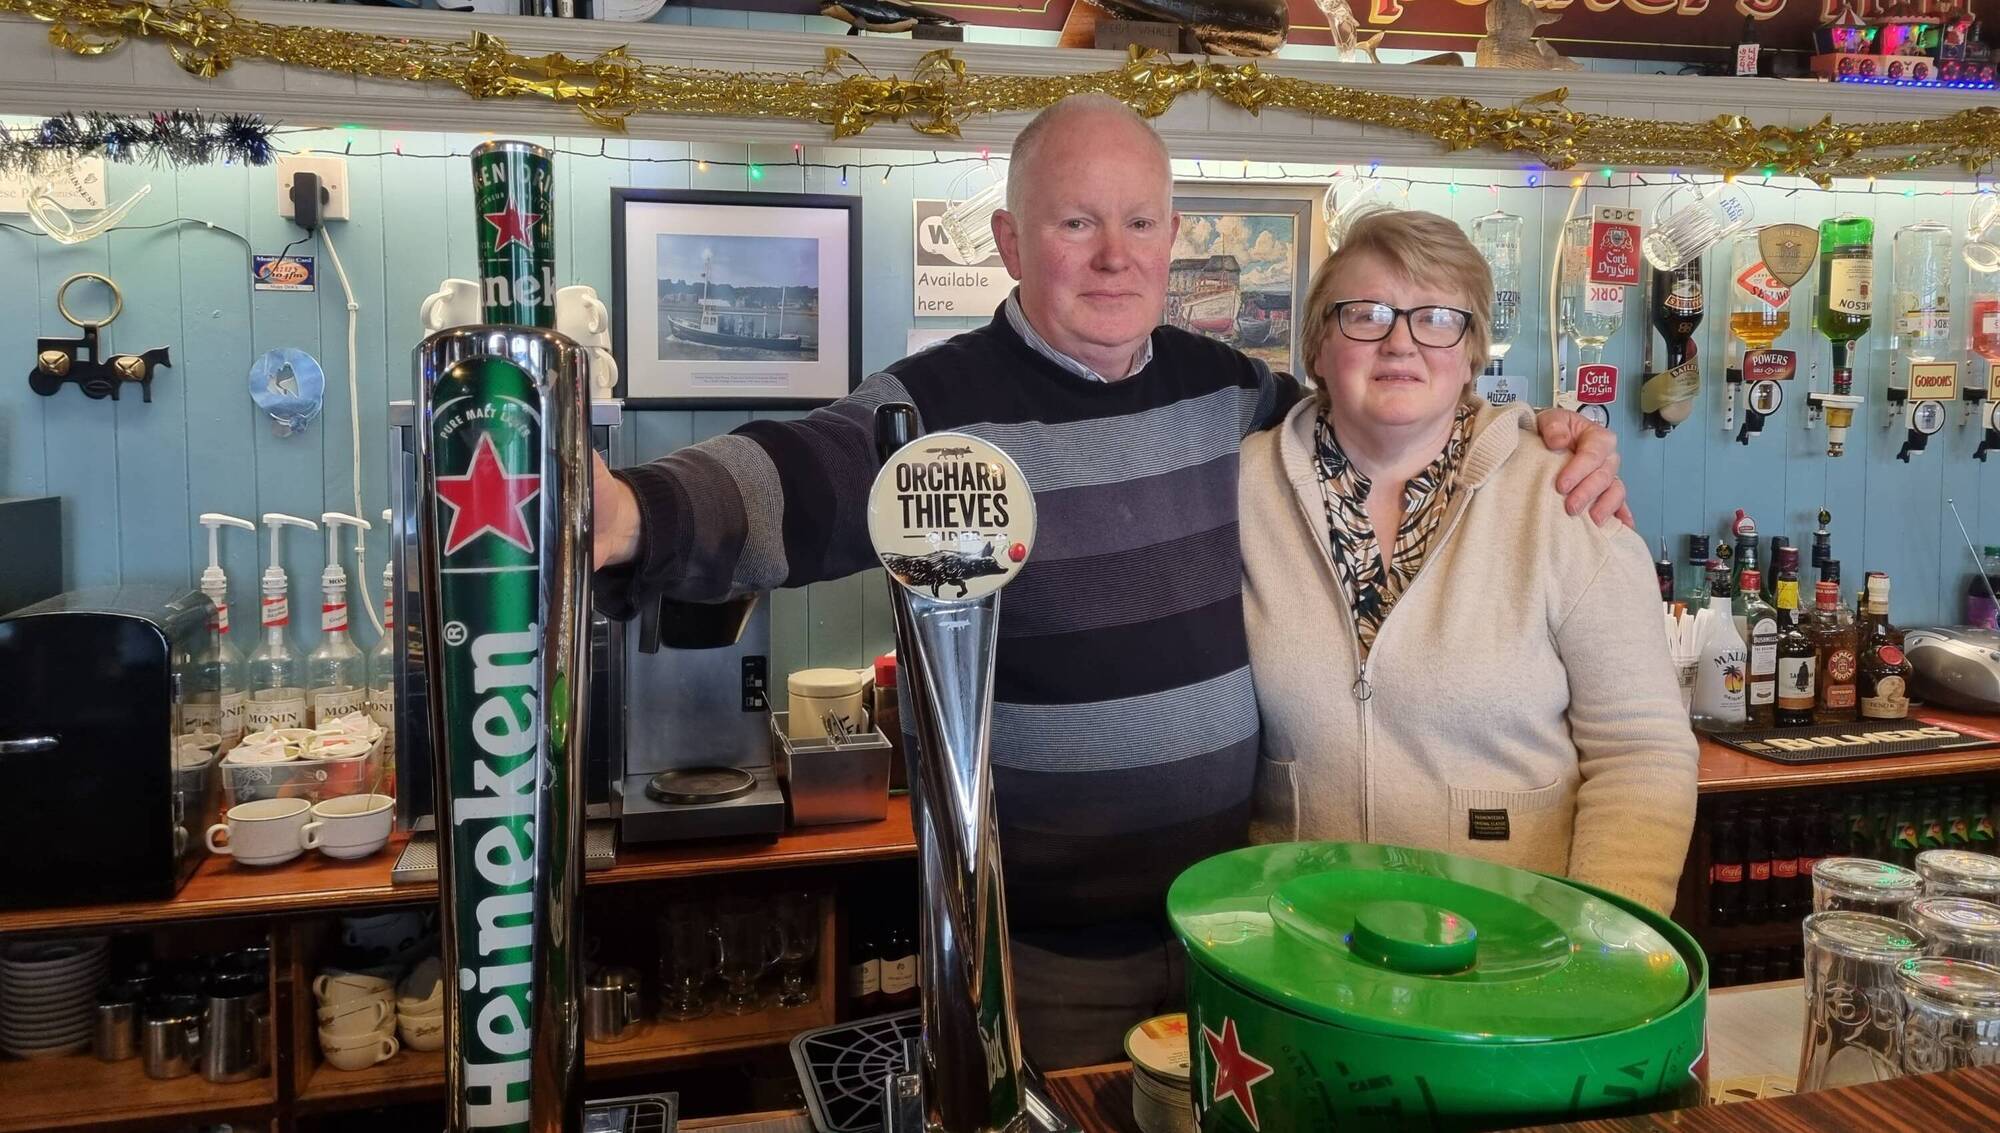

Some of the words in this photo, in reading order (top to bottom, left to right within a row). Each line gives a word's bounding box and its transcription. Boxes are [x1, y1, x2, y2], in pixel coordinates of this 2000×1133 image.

[1606, 252, 1628, 265] Cork
[1597, 260, 1617, 276] Dry
[1617, 264, 1635, 278] Gin
[918, 271, 989, 288] Available
[918, 295, 954, 311] here
[1752, 353, 1789, 366] POWERS
[1585, 371, 1610, 386] Cork
[1486, 391, 1517, 403] HUZZAR
[1581, 384, 1598, 396] Dry
[1598, 384, 1613, 396] Gin
[440, 414, 465, 439] PURE
[465, 407, 497, 421] MALT
[896, 461, 1007, 493] ORCHARD
[897, 493, 1010, 529] THIEVES
[249, 711, 298, 725] MONIN
[1764, 726, 1960, 751] BULMERS
[454, 621, 538, 1129] Heineken
